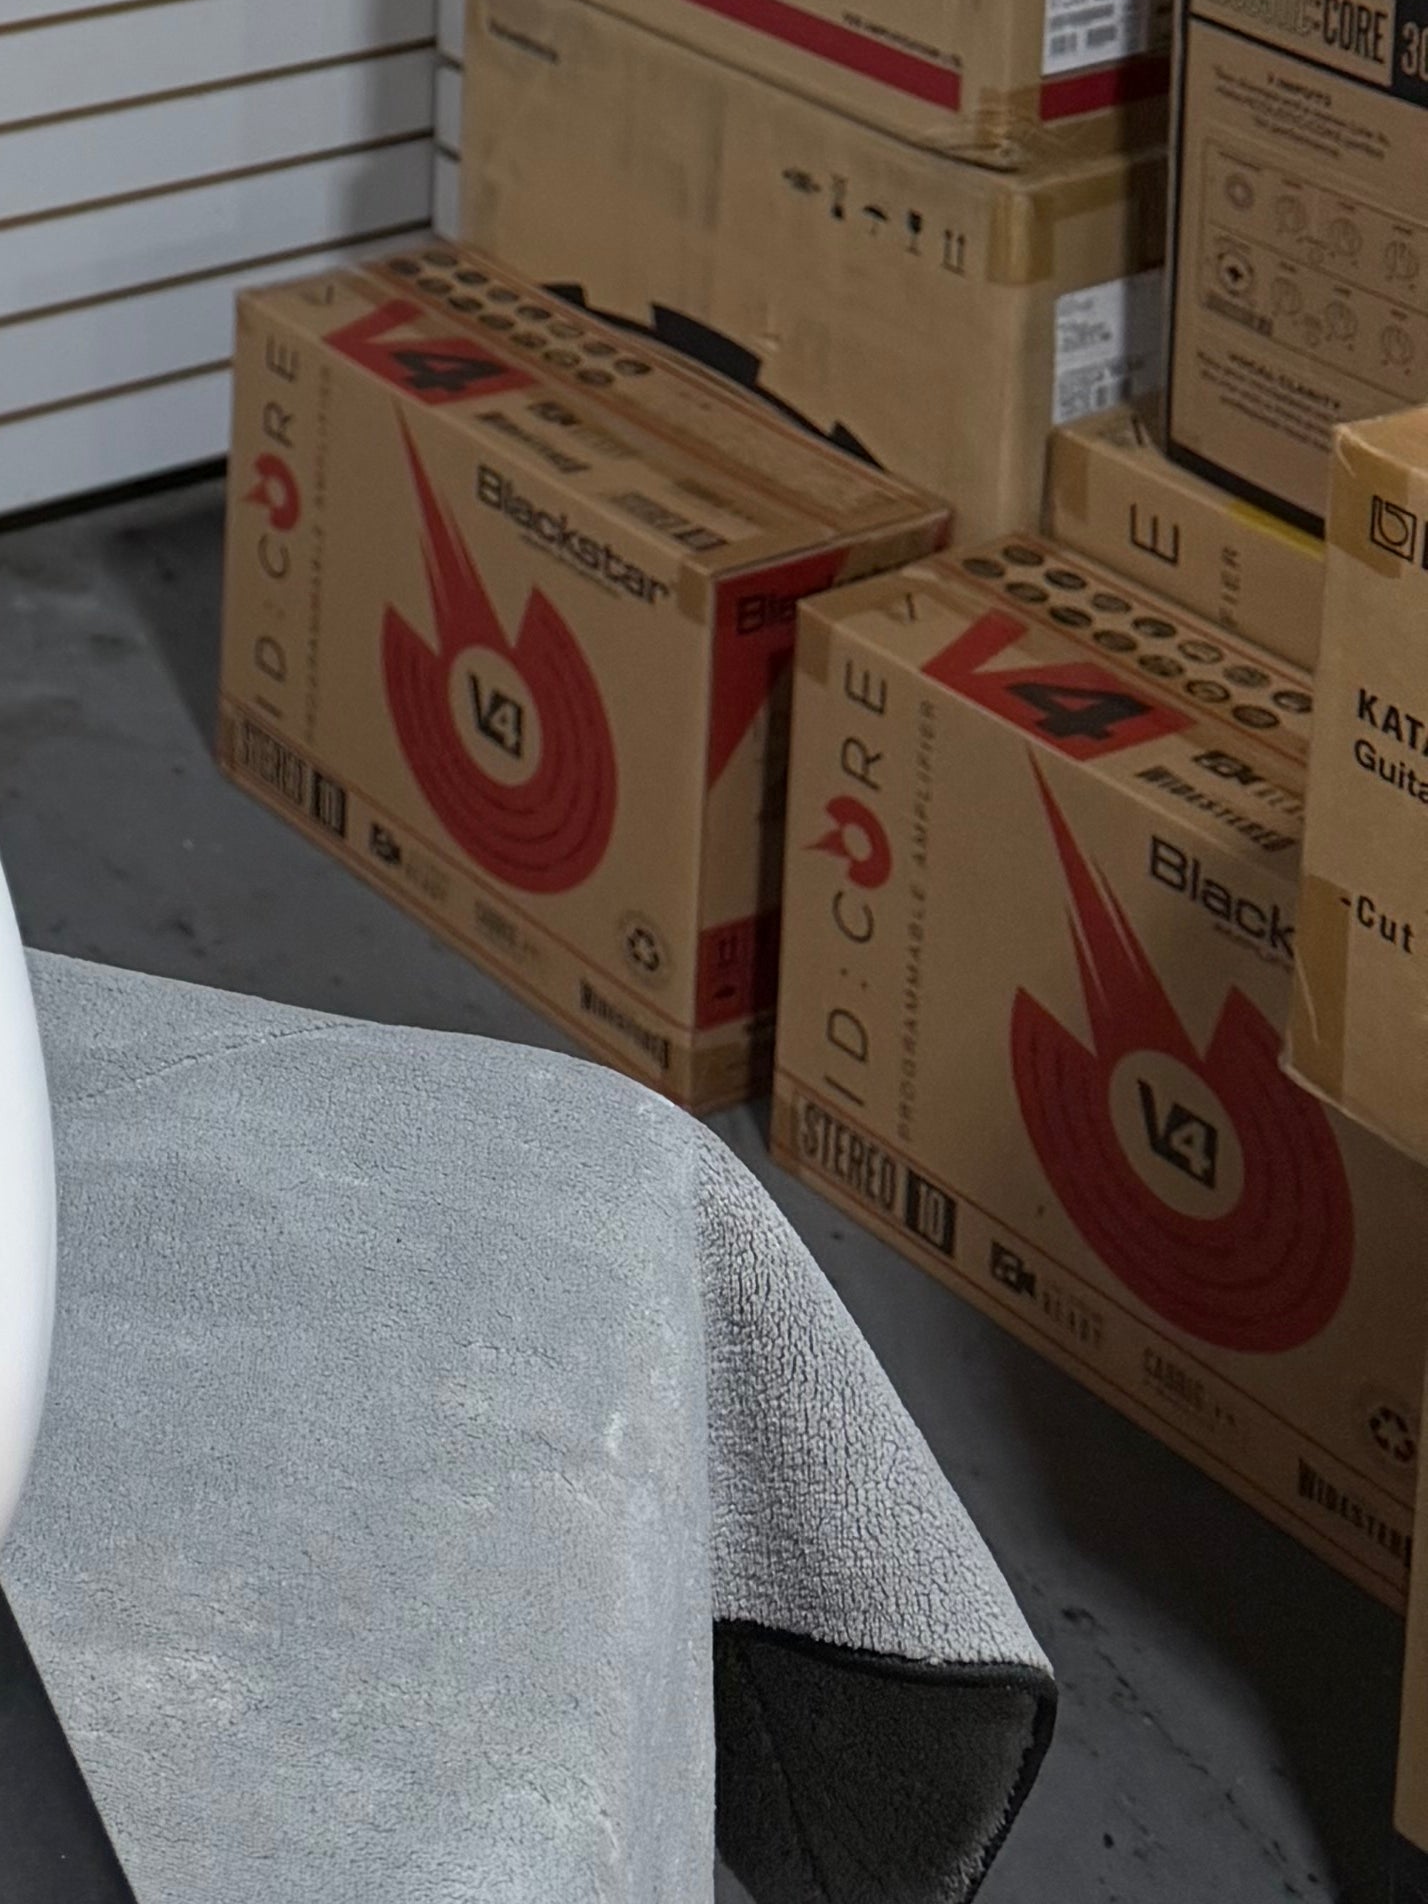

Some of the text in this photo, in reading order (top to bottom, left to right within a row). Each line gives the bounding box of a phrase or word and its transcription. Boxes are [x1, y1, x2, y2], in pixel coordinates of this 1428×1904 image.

[477, 463, 670, 605] Blackstar
[1358, 687, 1428, 758] KAT
[798, 1100, 896, 1212] STEREO
